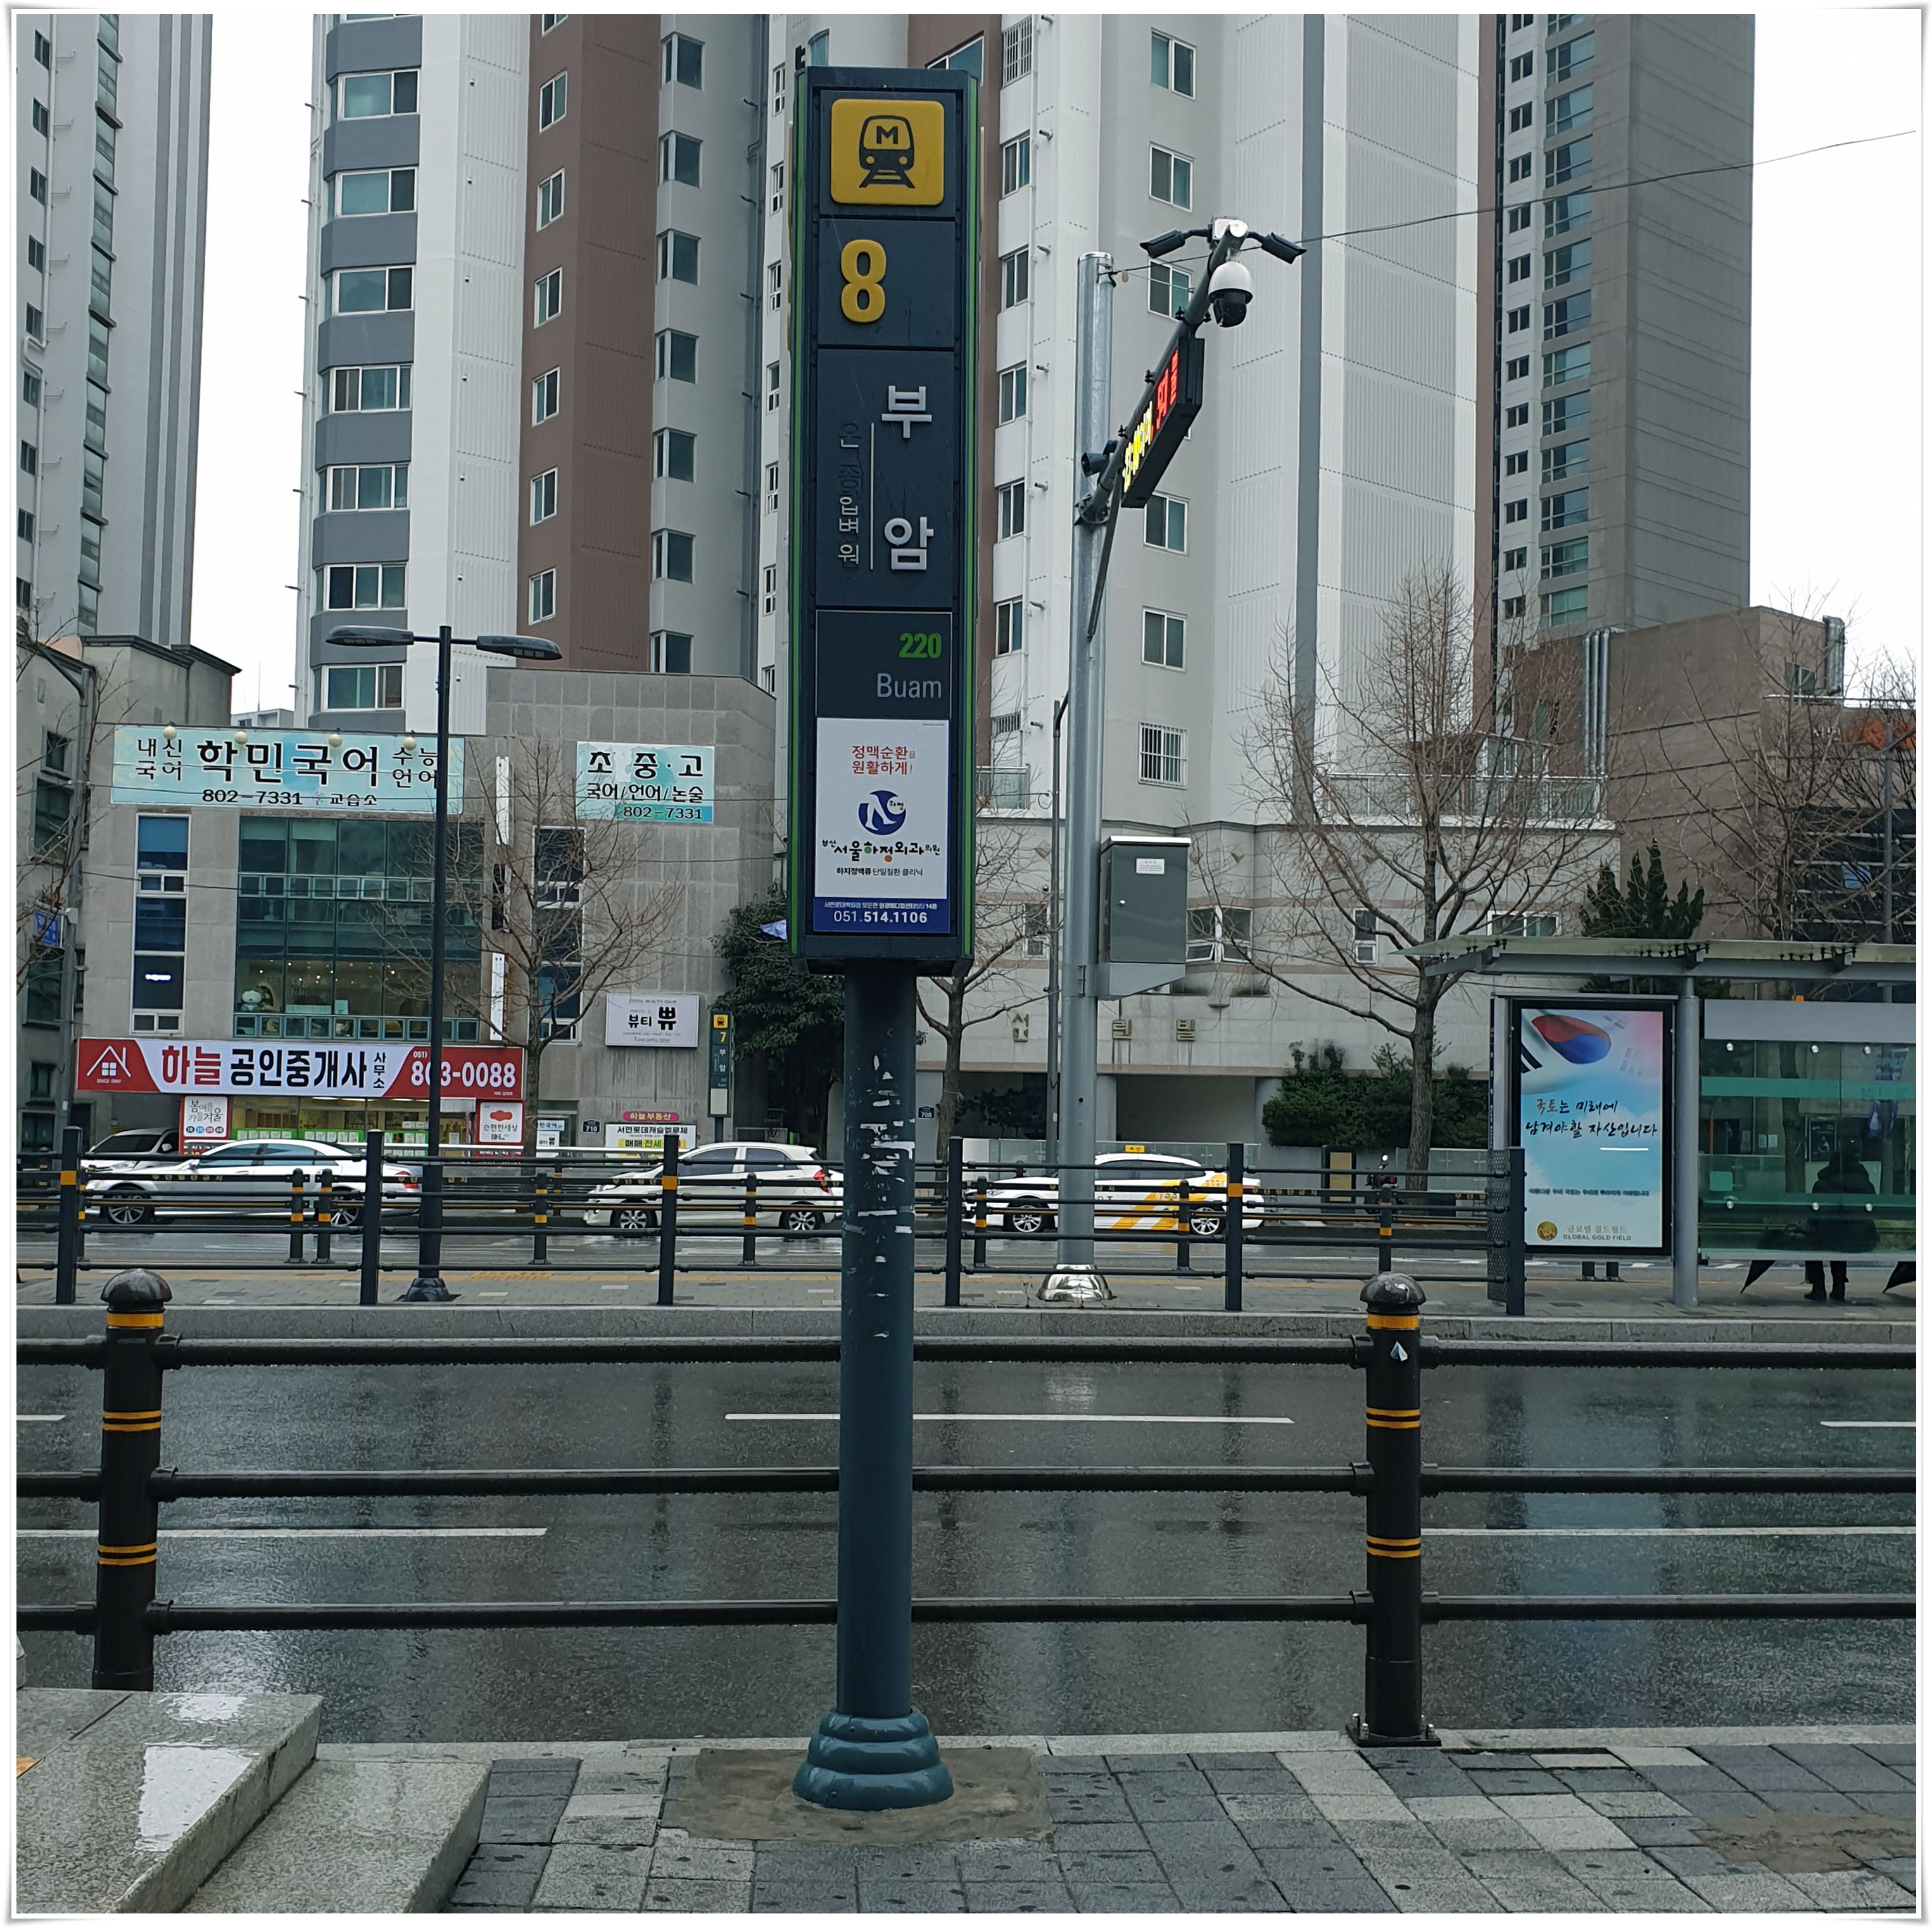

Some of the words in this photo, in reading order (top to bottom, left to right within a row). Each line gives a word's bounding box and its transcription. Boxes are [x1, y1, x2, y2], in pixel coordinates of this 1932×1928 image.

[876, 125, 899, 144] M
[841, 239, 887, 324] 8
[899, 633, 942, 658] 220
[876, 672, 942, 698] Buam
[136, 760, 181, 781] 국어
[197, 740, 378, 787] 학민국어
[202, 789, 303, 805] 802-7331
[330, 793, 378, 807] 교습소
[622, 806, 704, 820] 802-7331
[833, 910, 928, 923] 051.514.1106
[628, 1014, 652, 1028] 뷰티
[719, 1031, 726, 1043] 7
[161, 1045, 222, 1086] 하늘
[230, 1048, 367, 1089] 공인중개사
[373, 1052, 386, 1089] 사무소
[1536, 1099, 1570, 1115] 국토는
[1575, 1100, 1618, 1116] 미래에
[1588, 1121, 1658, 1138] 자산입니다
